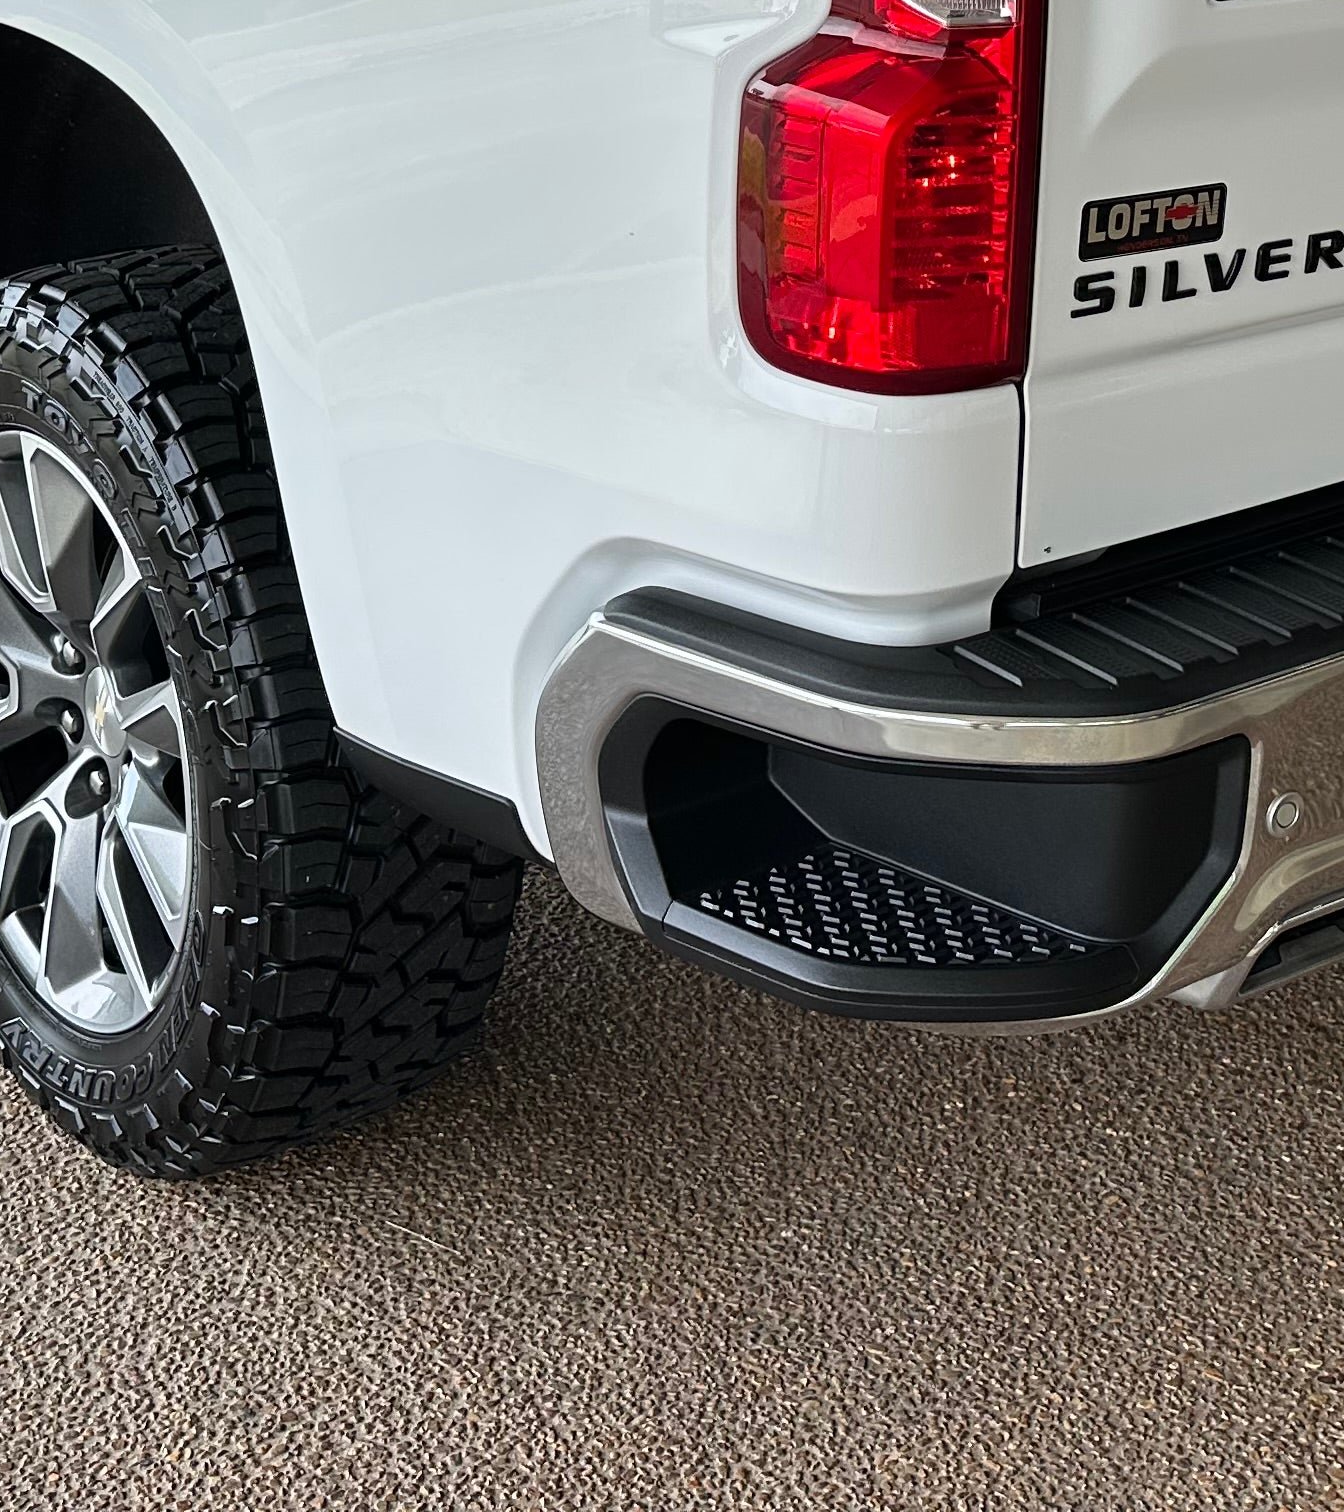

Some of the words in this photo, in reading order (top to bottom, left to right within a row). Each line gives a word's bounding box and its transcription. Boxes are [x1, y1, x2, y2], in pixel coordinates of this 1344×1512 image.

[1087, 189, 1221, 244] LOFTON
[21, 379, 116, 501] TOYO
[157, 909, 206, 1073] OPEN
[0, 1016, 155, 1102] COUNTRY
